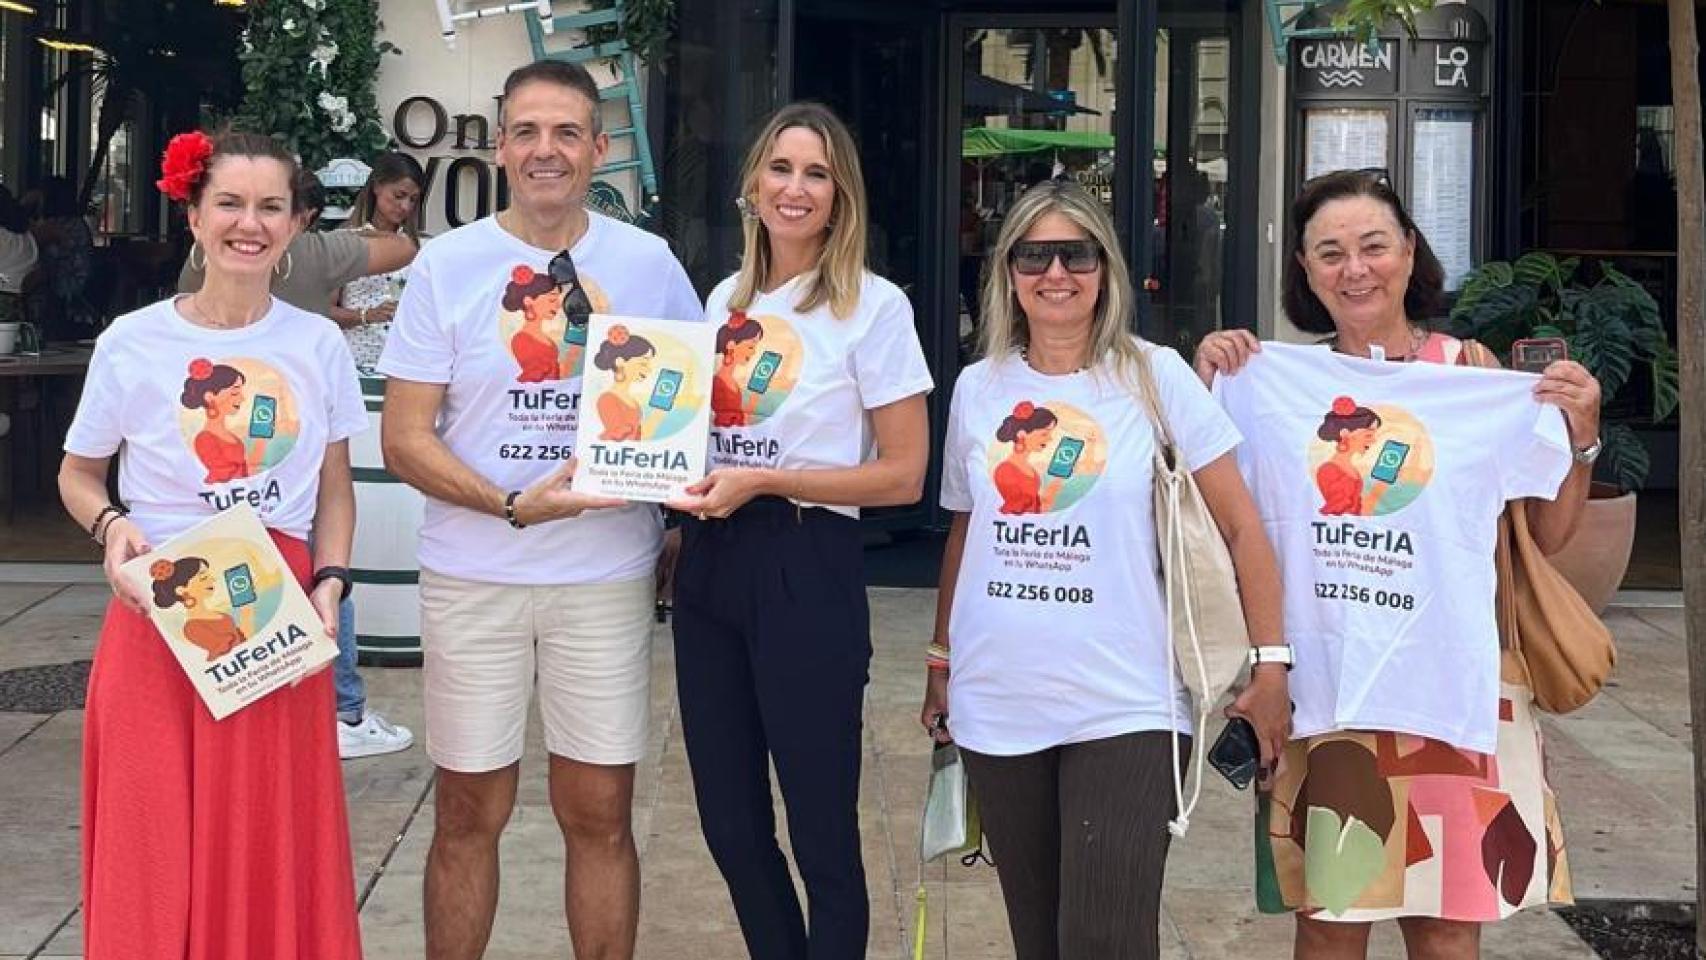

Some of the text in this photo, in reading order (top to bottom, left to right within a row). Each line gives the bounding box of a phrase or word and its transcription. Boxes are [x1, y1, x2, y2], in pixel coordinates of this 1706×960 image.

[1301, 40, 1392, 72] CARMEN
[508, 389, 582, 410] TuFer
[499, 444, 572, 460] 622 256
[589, 445, 688, 471] TuFerIA
[993, 520, 1091, 548] TuFerIA
[1311, 521, 1414, 555] TuFerIA
[987, 581, 1093, 604] 622 256 008
[1341, 583, 1370, 603] 256
[1375, 590, 1414, 610] 008
[204, 624, 307, 683] TuFerIA
